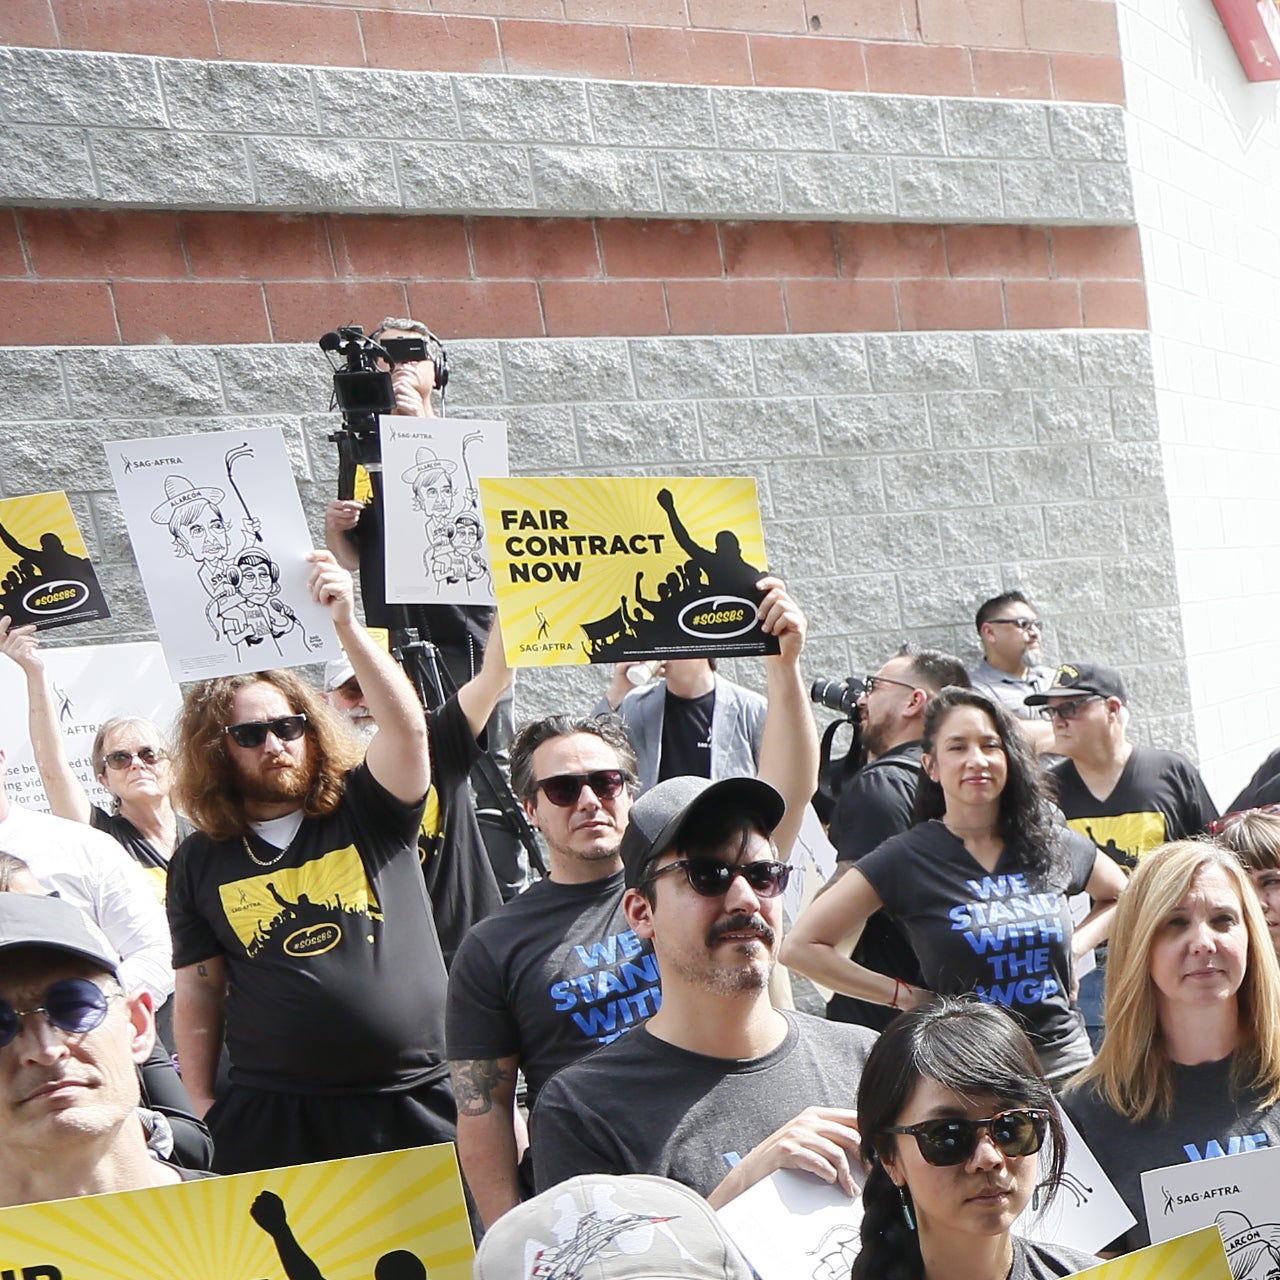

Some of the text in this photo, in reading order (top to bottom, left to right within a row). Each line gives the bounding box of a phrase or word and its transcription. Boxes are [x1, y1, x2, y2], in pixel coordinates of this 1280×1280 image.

[501, 509, 569, 530] FAIR
[505, 534, 665, 557] CONTRACT
[509, 561, 582, 583] NOW
[35, 588, 77, 607] #SOSSBS
[692, 610, 744, 626] #SOSSBS
[519, 641, 574, 653] SAG·AFTRA
[22, 763, 36, 774] be
[966, 873, 1029, 900] WE
[949, 893, 1061, 931] STAND
[963, 917, 1063, 955] WITH
[574, 929, 642, 968] WE
[987, 950, 1050, 980] THE
[976, 978, 1059, 1007] WGA
[1183, 1132, 1268, 1162] WE
[1176, 1184, 1240, 1206] SAG·AFTRA
[1226, 1230, 1261, 1252] LARCÓN
